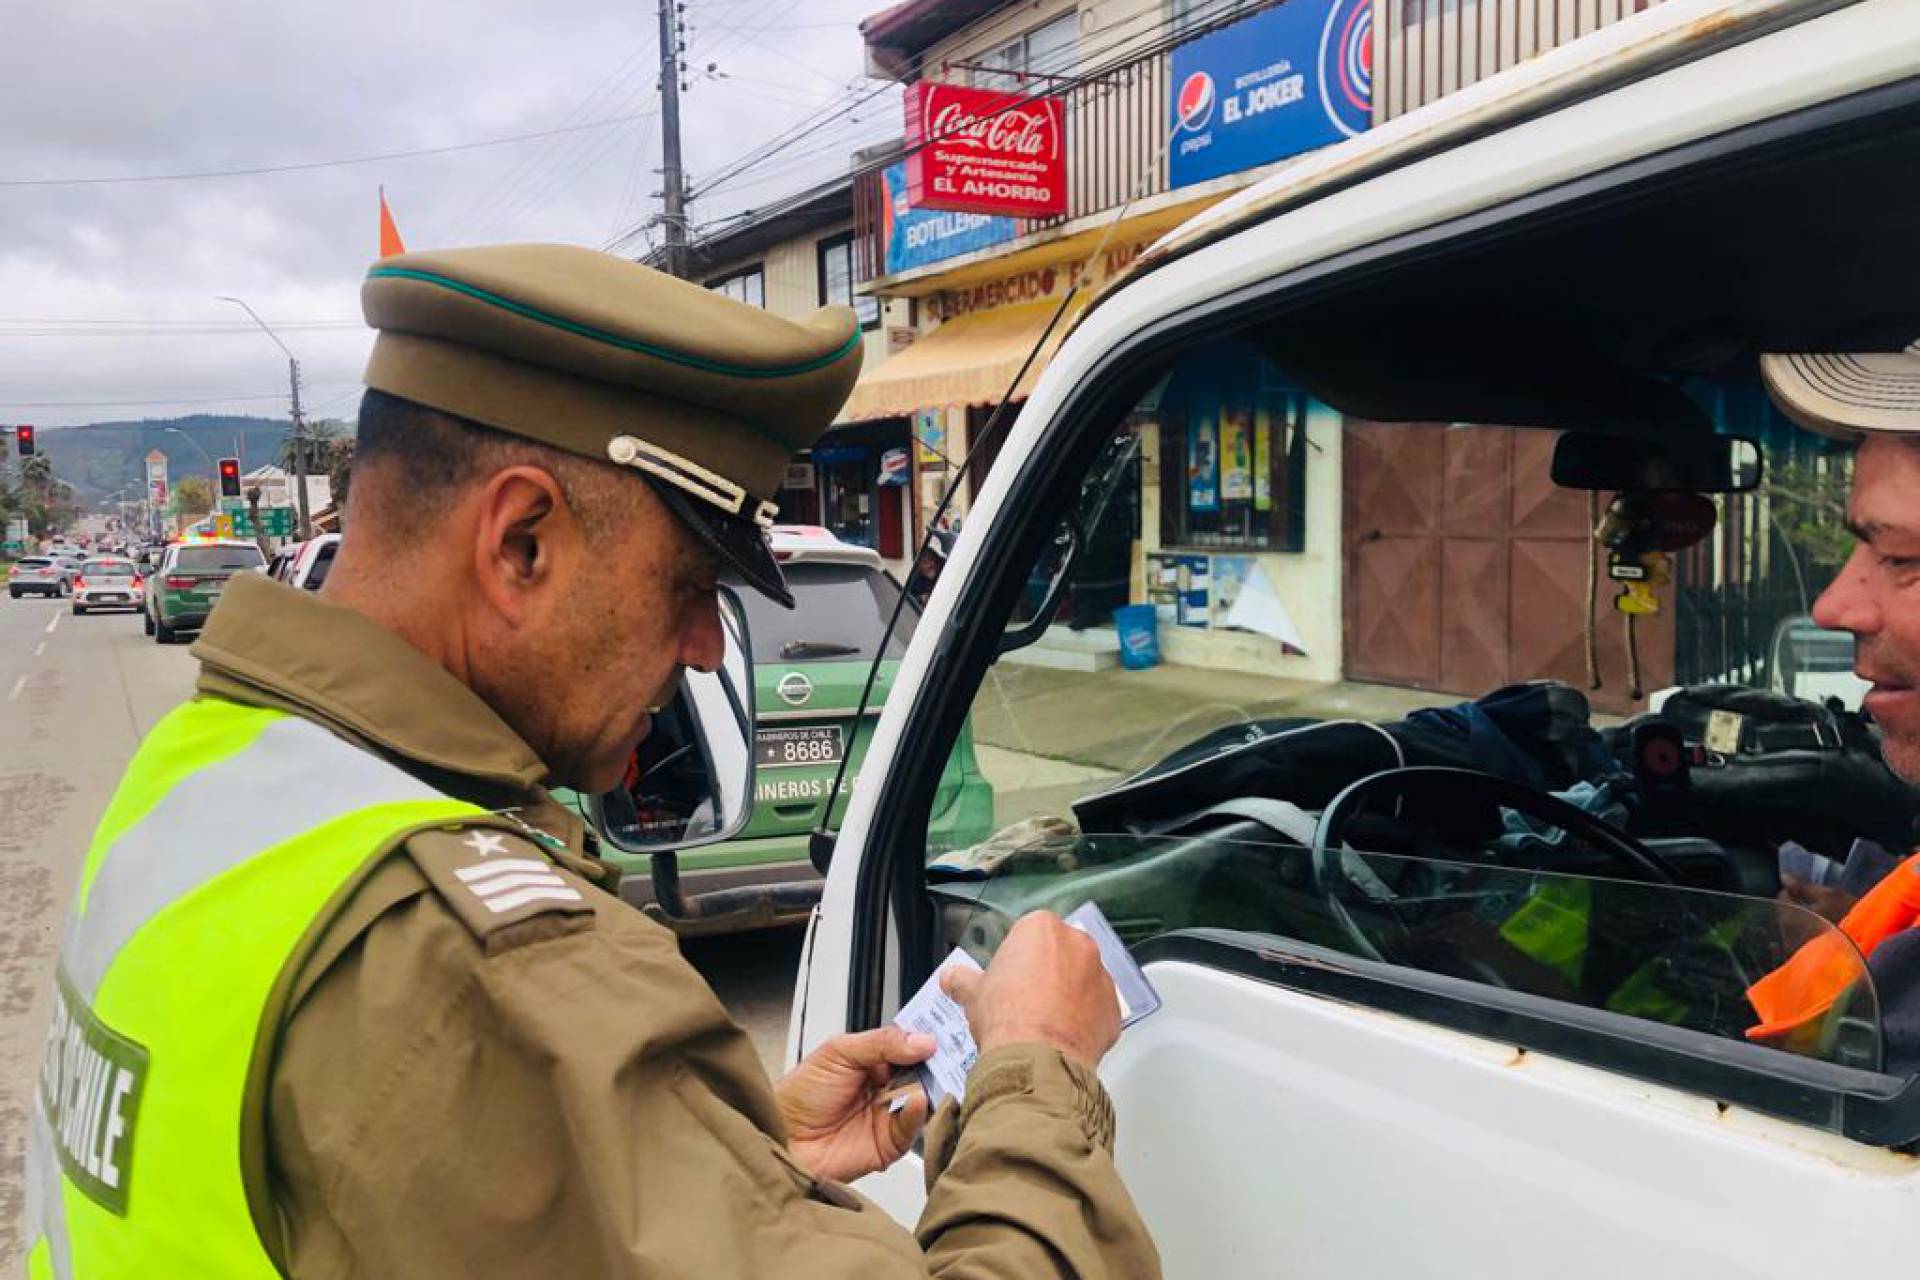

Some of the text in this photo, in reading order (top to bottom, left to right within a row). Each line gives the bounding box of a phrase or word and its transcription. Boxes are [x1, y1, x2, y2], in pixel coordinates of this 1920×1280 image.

[1223, 73, 1304, 124] EL JOKER
[1180, 131, 1212, 156] pepsi
[934, 150, 1048, 173] Supermercado
[945, 166, 956, 177] y
[933, 177, 1051, 202] EL AHORRO
[784, 740, 833, 761] 8686
[754, 779, 821, 801] INEROS
